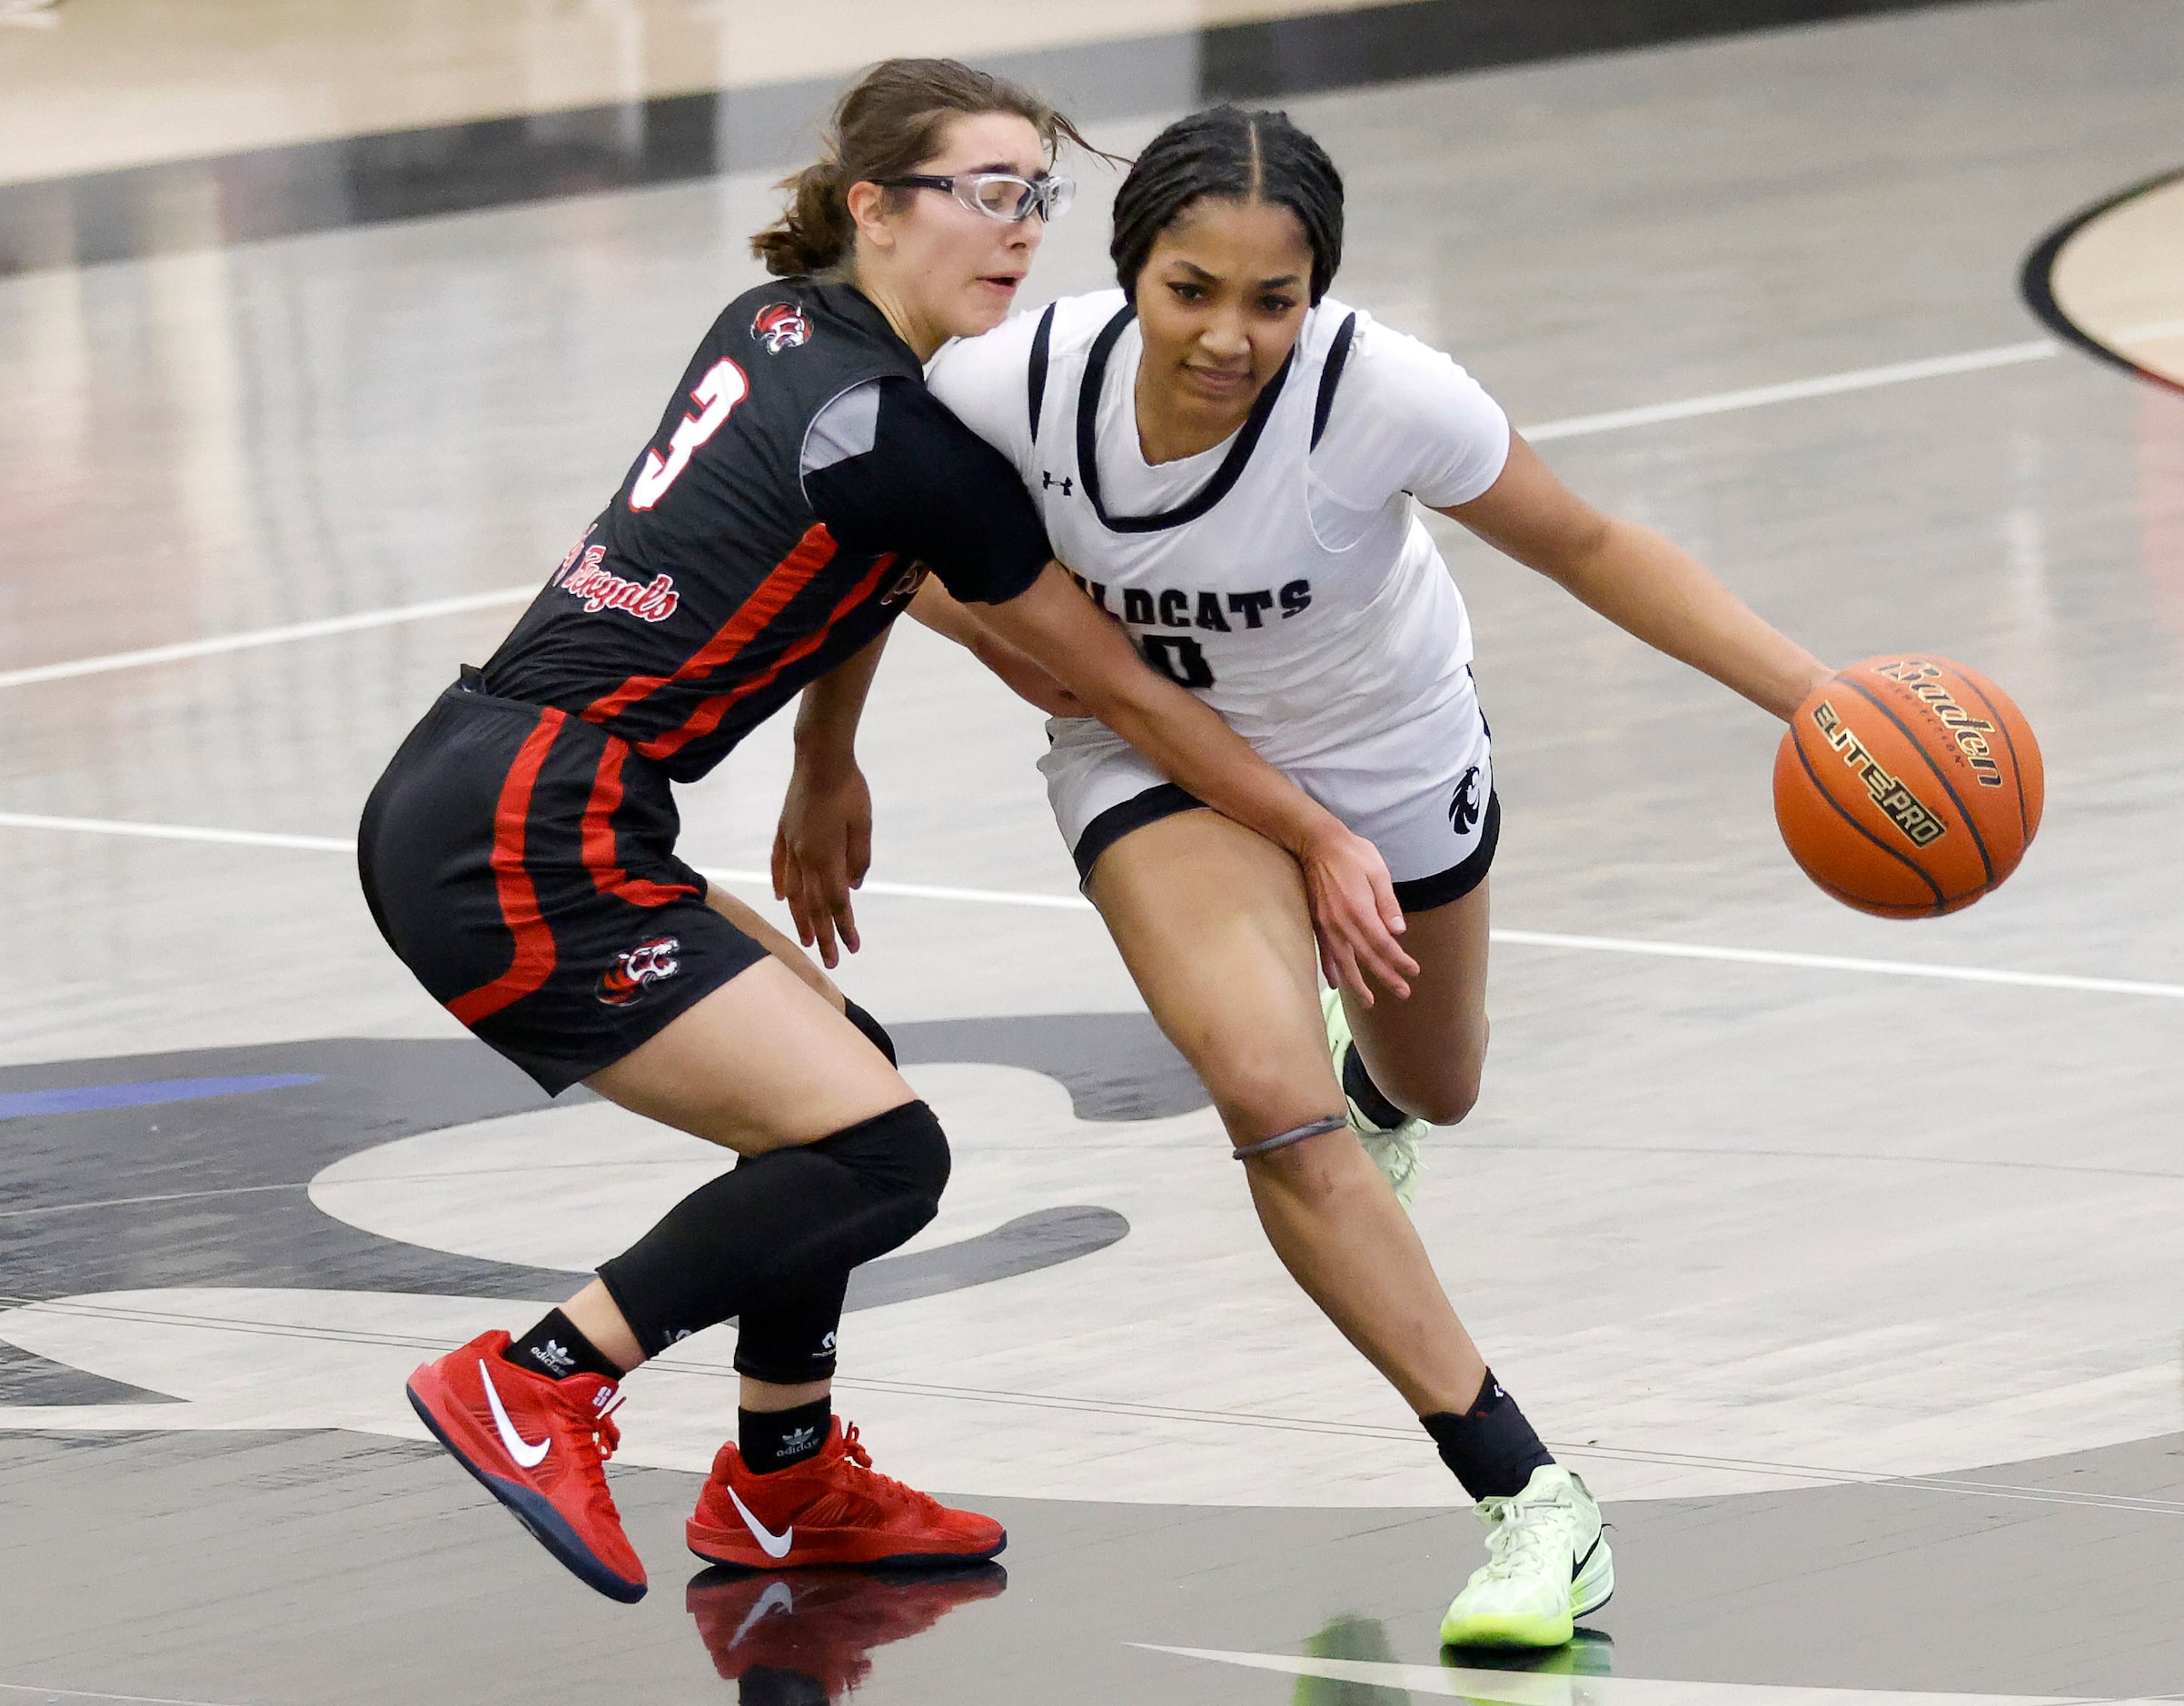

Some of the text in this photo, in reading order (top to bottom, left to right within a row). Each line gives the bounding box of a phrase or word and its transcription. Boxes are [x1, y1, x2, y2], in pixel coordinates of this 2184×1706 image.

[629, 356, 750, 511] 3
[1072, 571, 1312, 632] LDCATS
[1871, 661, 2002, 788] Baden
[1881, 789, 1940, 842] PRO
